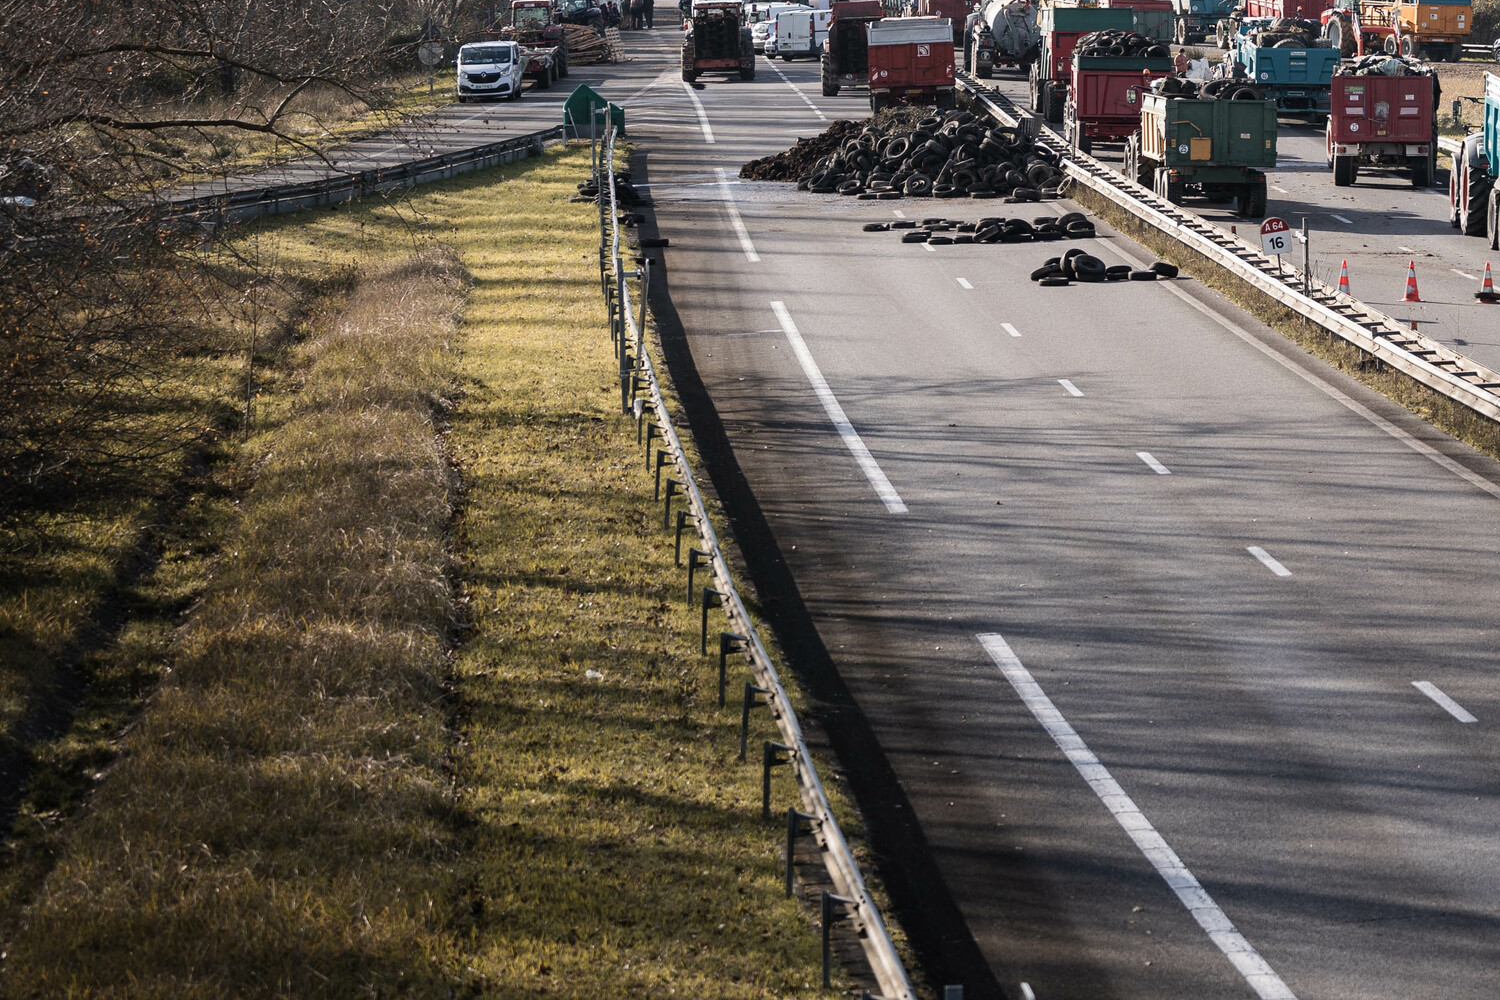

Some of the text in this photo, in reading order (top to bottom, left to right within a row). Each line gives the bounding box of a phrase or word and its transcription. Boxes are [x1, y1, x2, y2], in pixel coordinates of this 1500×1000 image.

[1265, 221, 1284, 231] A 64
[1269, 237, 1285, 250] 16
